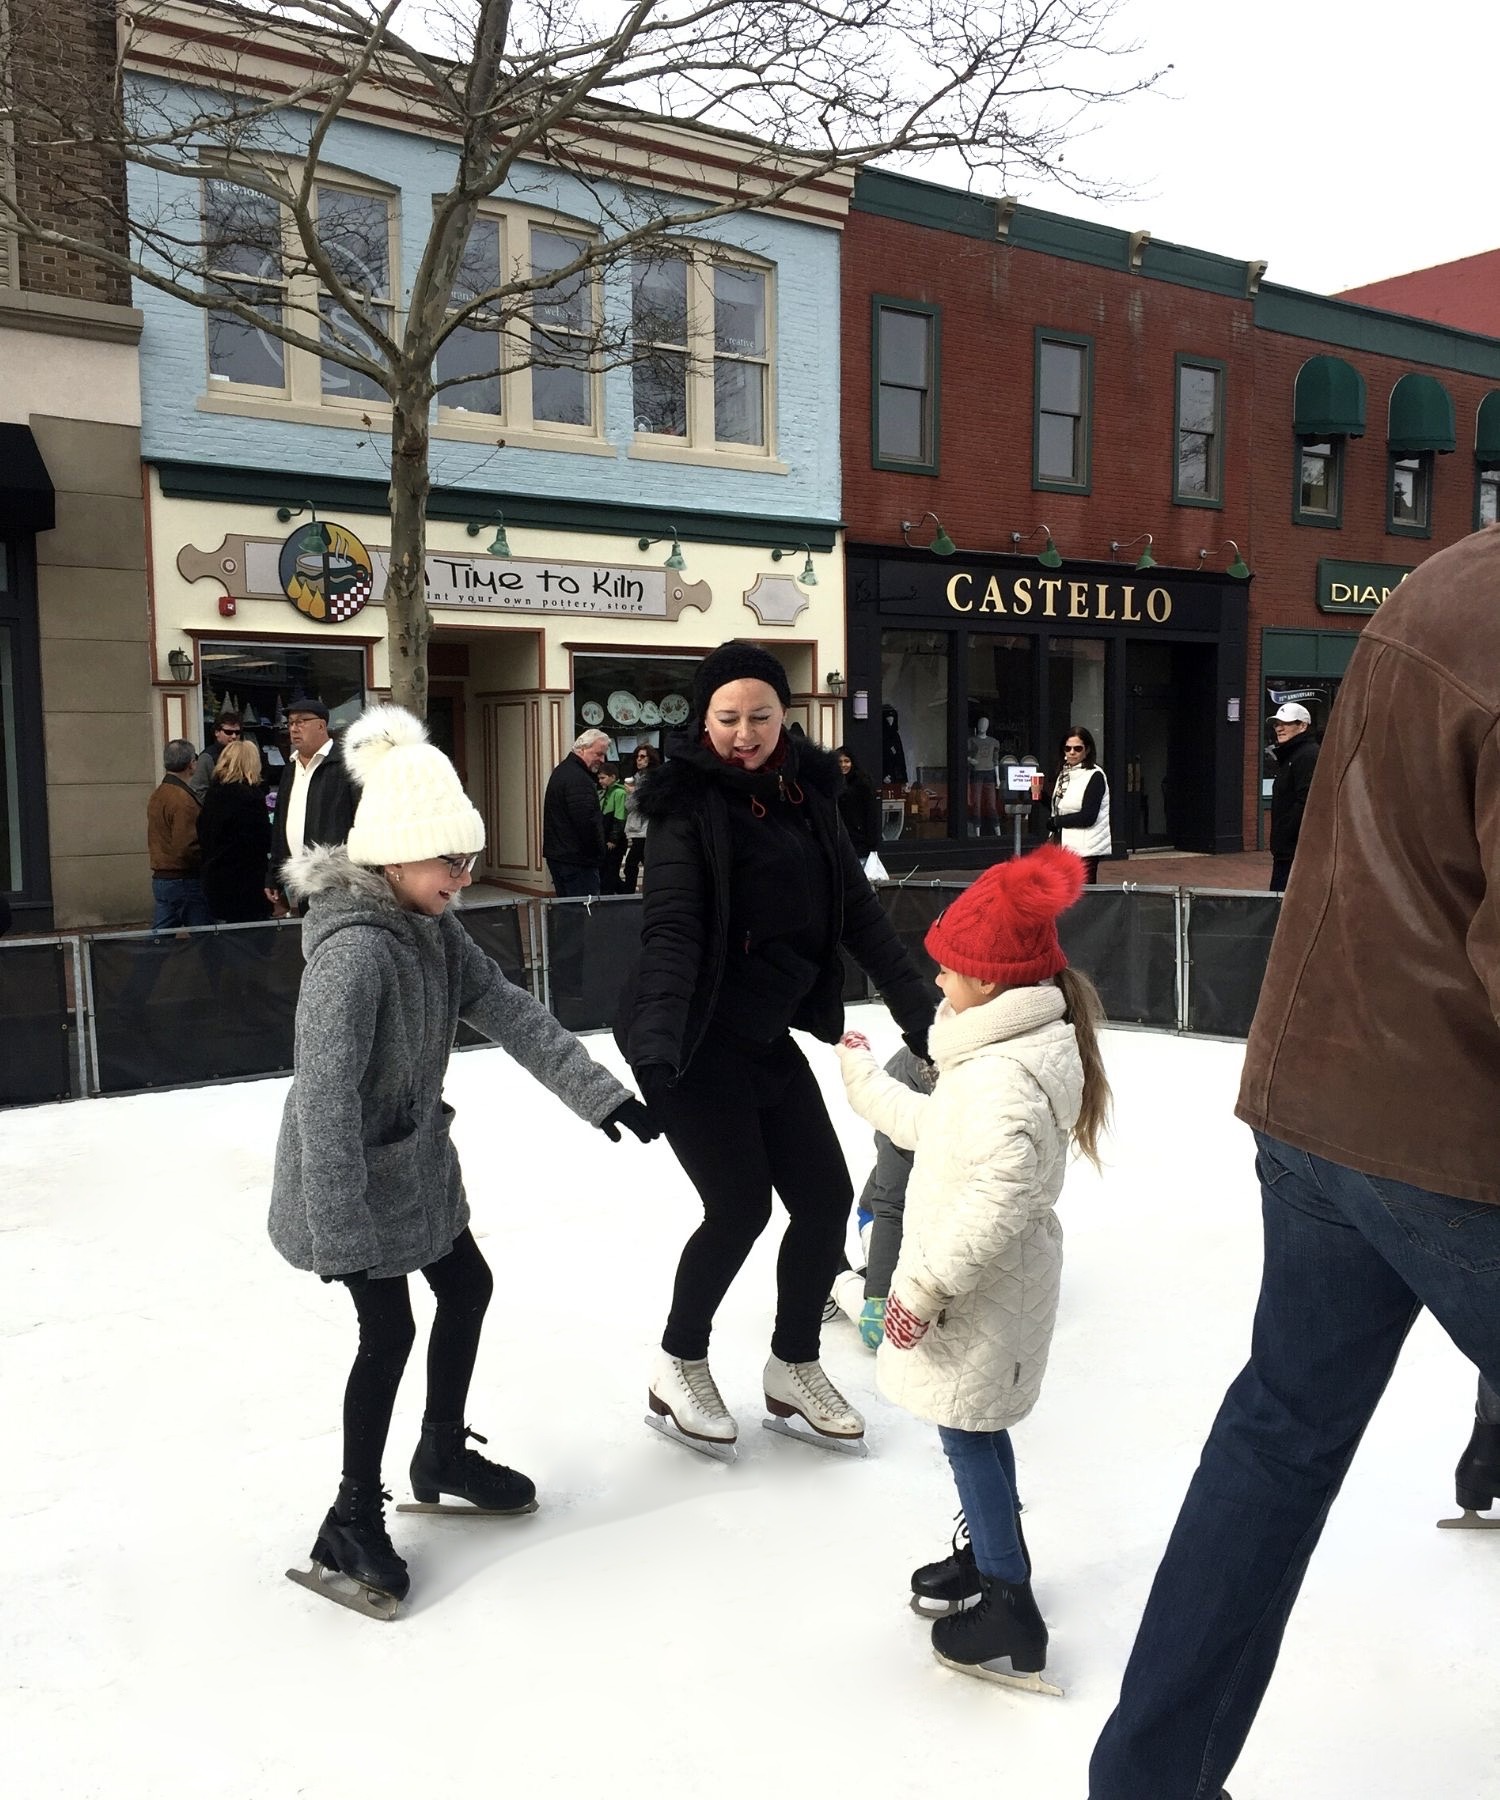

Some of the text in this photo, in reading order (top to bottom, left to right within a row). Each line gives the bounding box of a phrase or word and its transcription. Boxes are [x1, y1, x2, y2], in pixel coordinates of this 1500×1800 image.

[458, 593, 493, 604] your
[503, 596, 532, 606] own
[542, 597, 597, 610] pottery
[607, 601, 643, 612] store
[536, 569, 580, 595] to
[592, 570, 645, 603] Kiln
[946, 572, 1173, 623] CASTELLO
